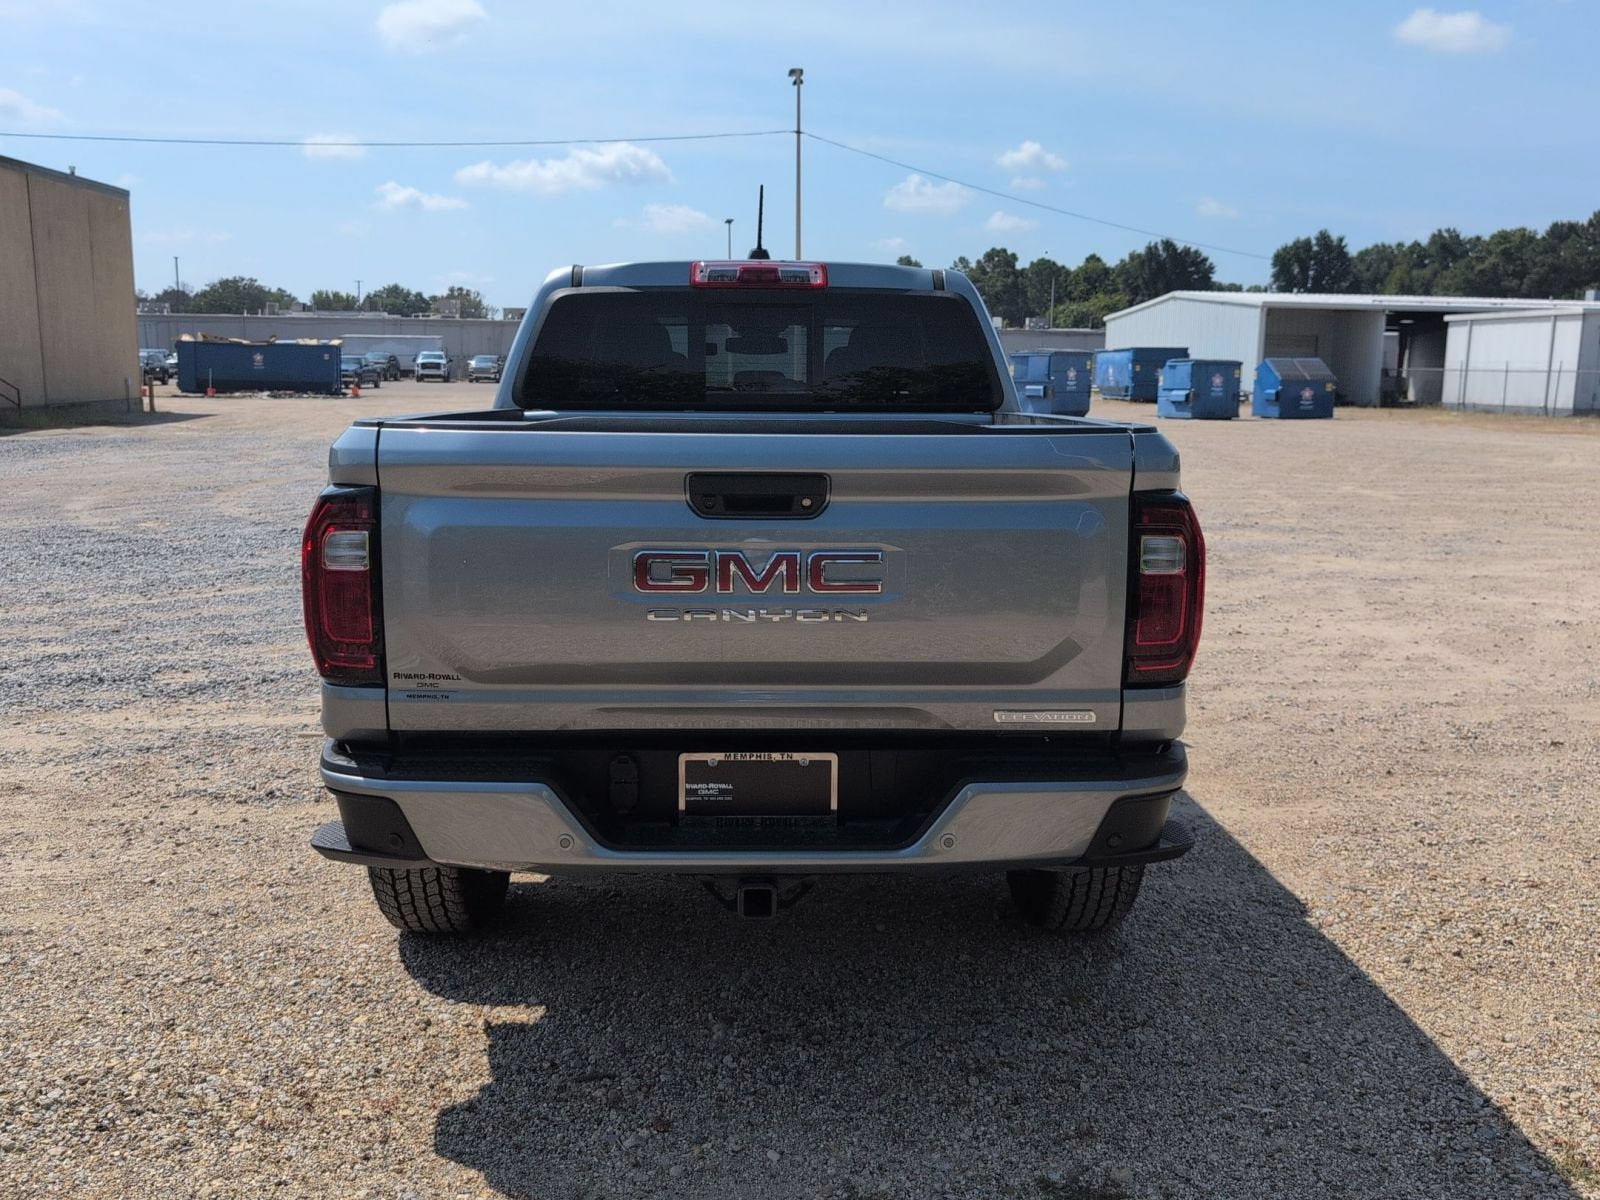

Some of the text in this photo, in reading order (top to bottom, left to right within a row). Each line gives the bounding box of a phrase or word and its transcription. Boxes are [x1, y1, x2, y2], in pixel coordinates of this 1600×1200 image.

[632, 550, 883, 594] GMC
[646, 608, 869, 622] CANYON
[393, 672, 462, 681] RIVARD-ROYALL
[724, 753, 776, 761] MEMPHIS,
